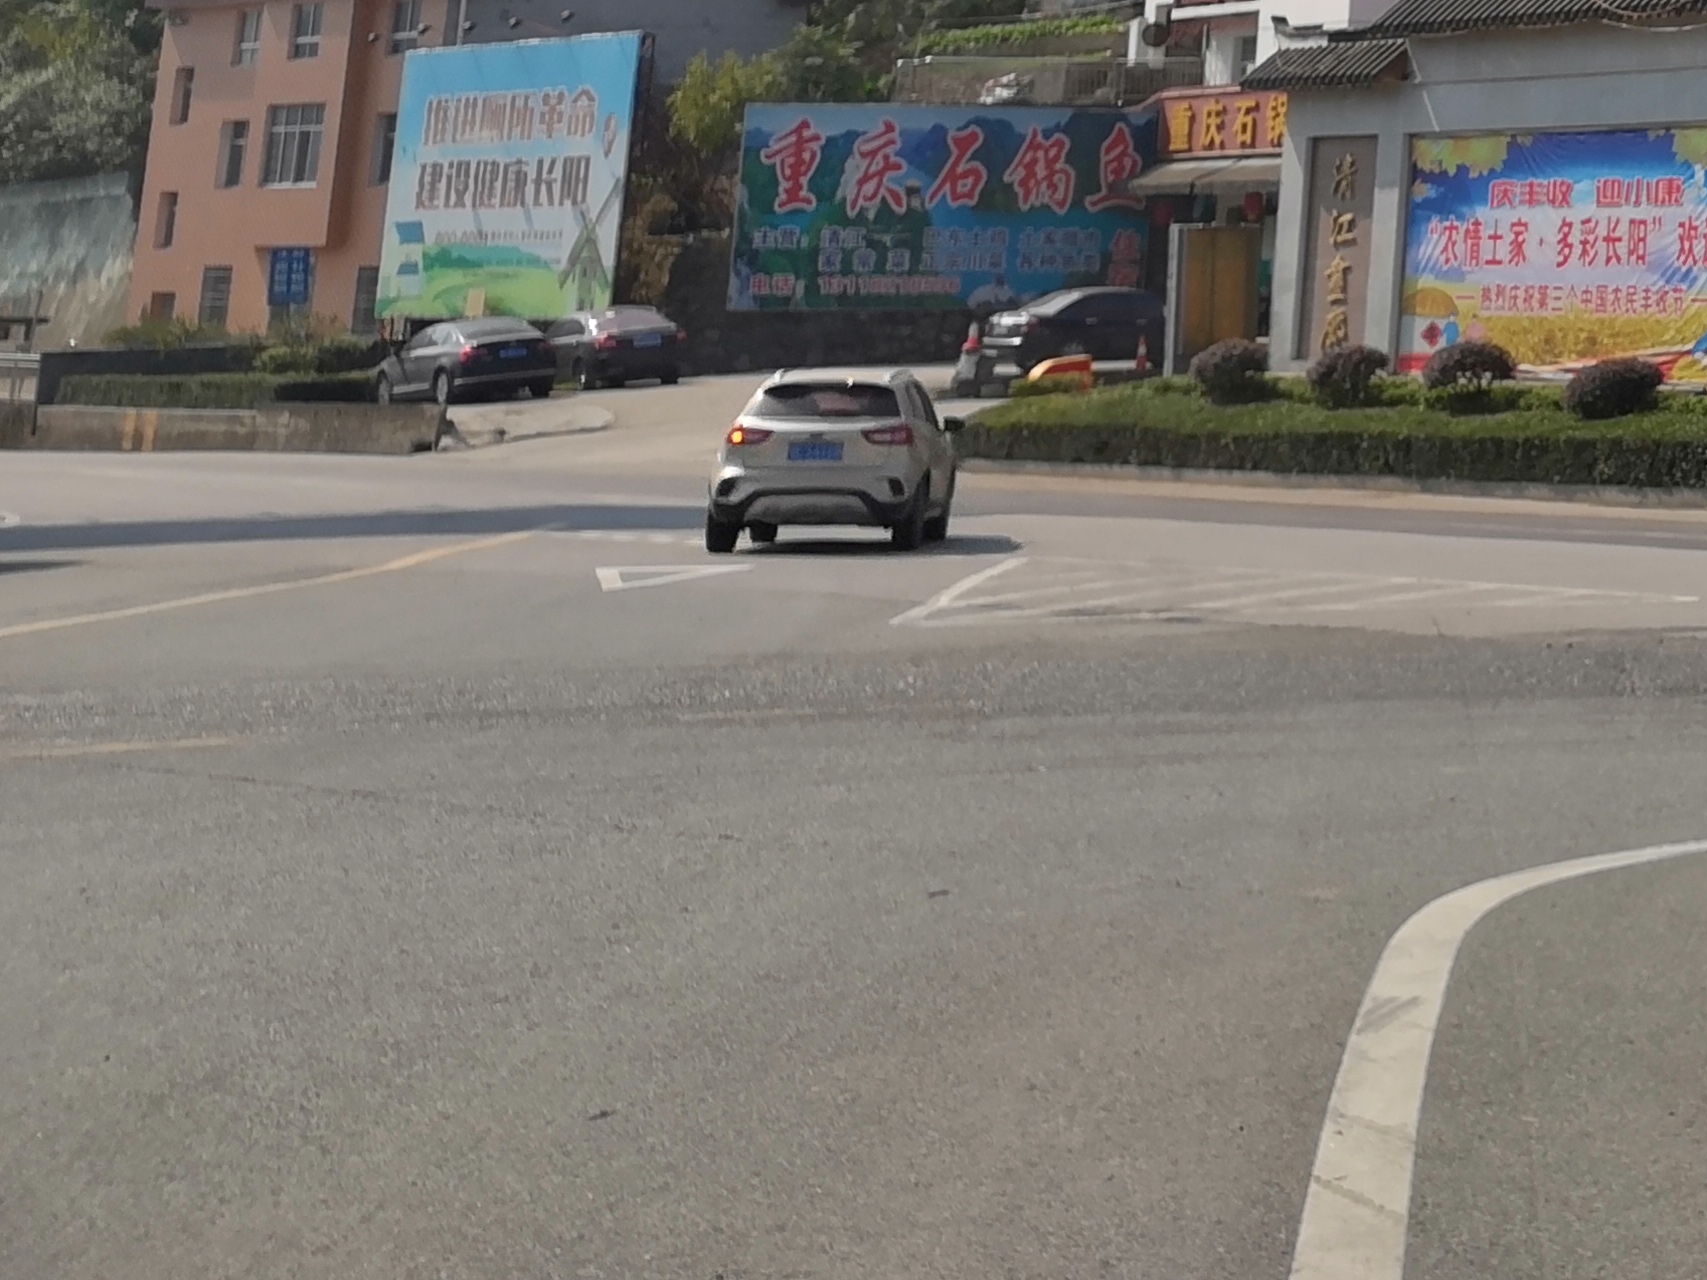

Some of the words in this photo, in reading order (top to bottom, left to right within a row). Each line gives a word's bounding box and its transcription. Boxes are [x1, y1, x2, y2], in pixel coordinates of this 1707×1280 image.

[415, 154, 591, 211] 建设健康长阳
[760, 117, 1146, 215] 重庆石锅鱼
[1488, 177, 1573, 208] 庆丰收
[1595, 176, 1684, 208] 迎小康
